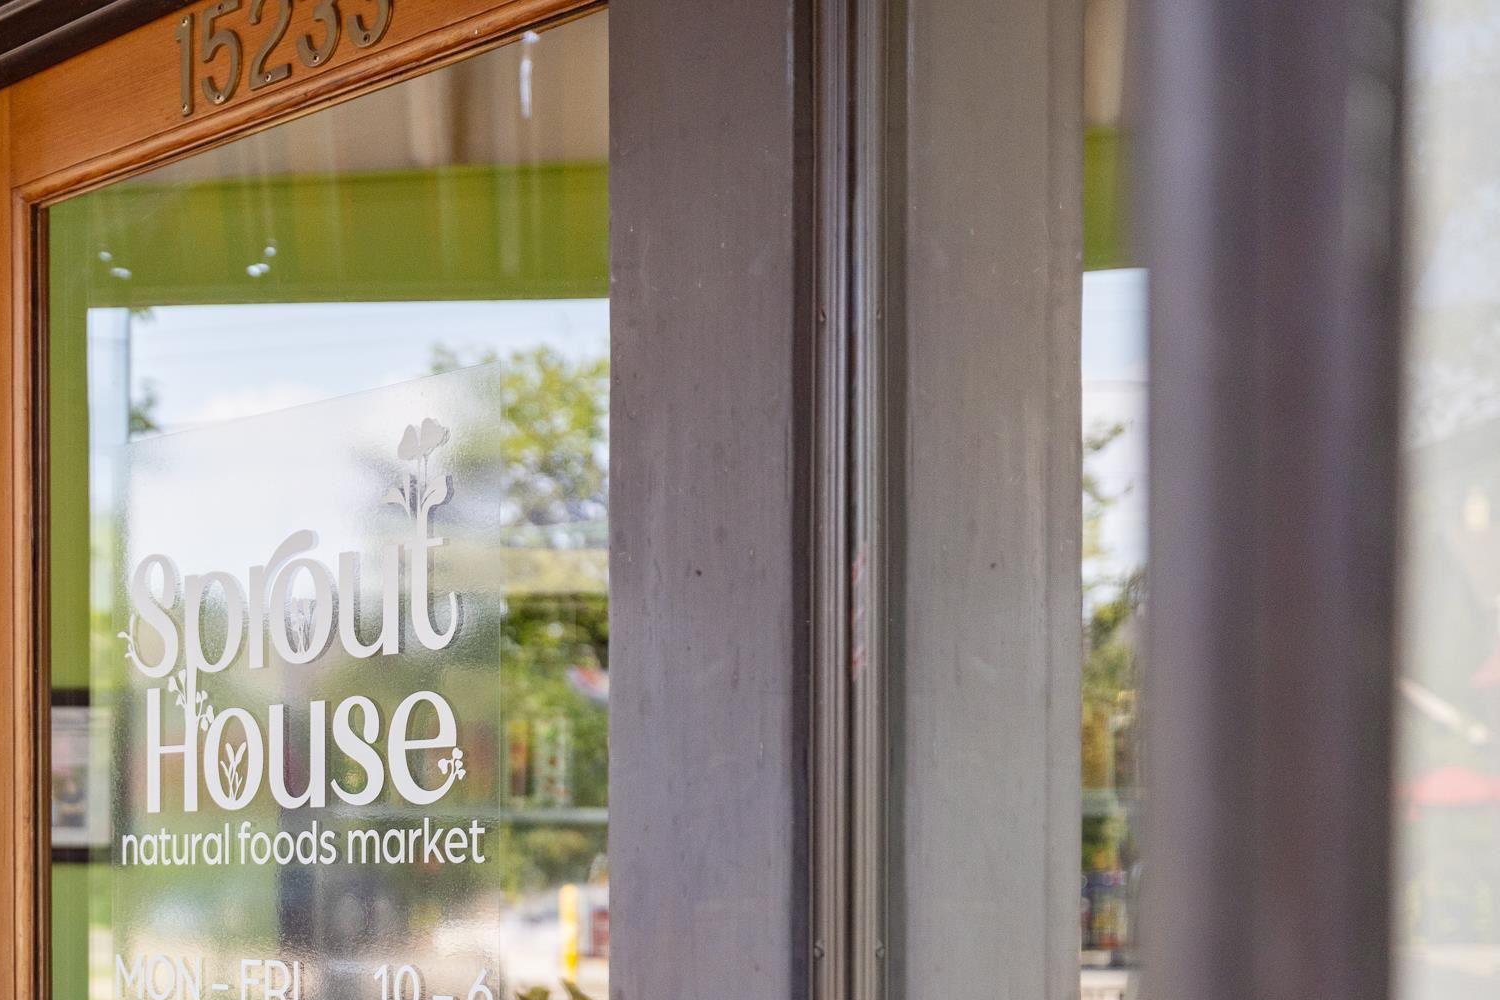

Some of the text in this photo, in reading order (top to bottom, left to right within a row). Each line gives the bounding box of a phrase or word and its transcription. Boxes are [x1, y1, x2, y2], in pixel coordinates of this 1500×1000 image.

[118, 495, 462, 682] Sprout
[147, 689, 465, 813] House
[121, 817, 486, 866] natural foods market
